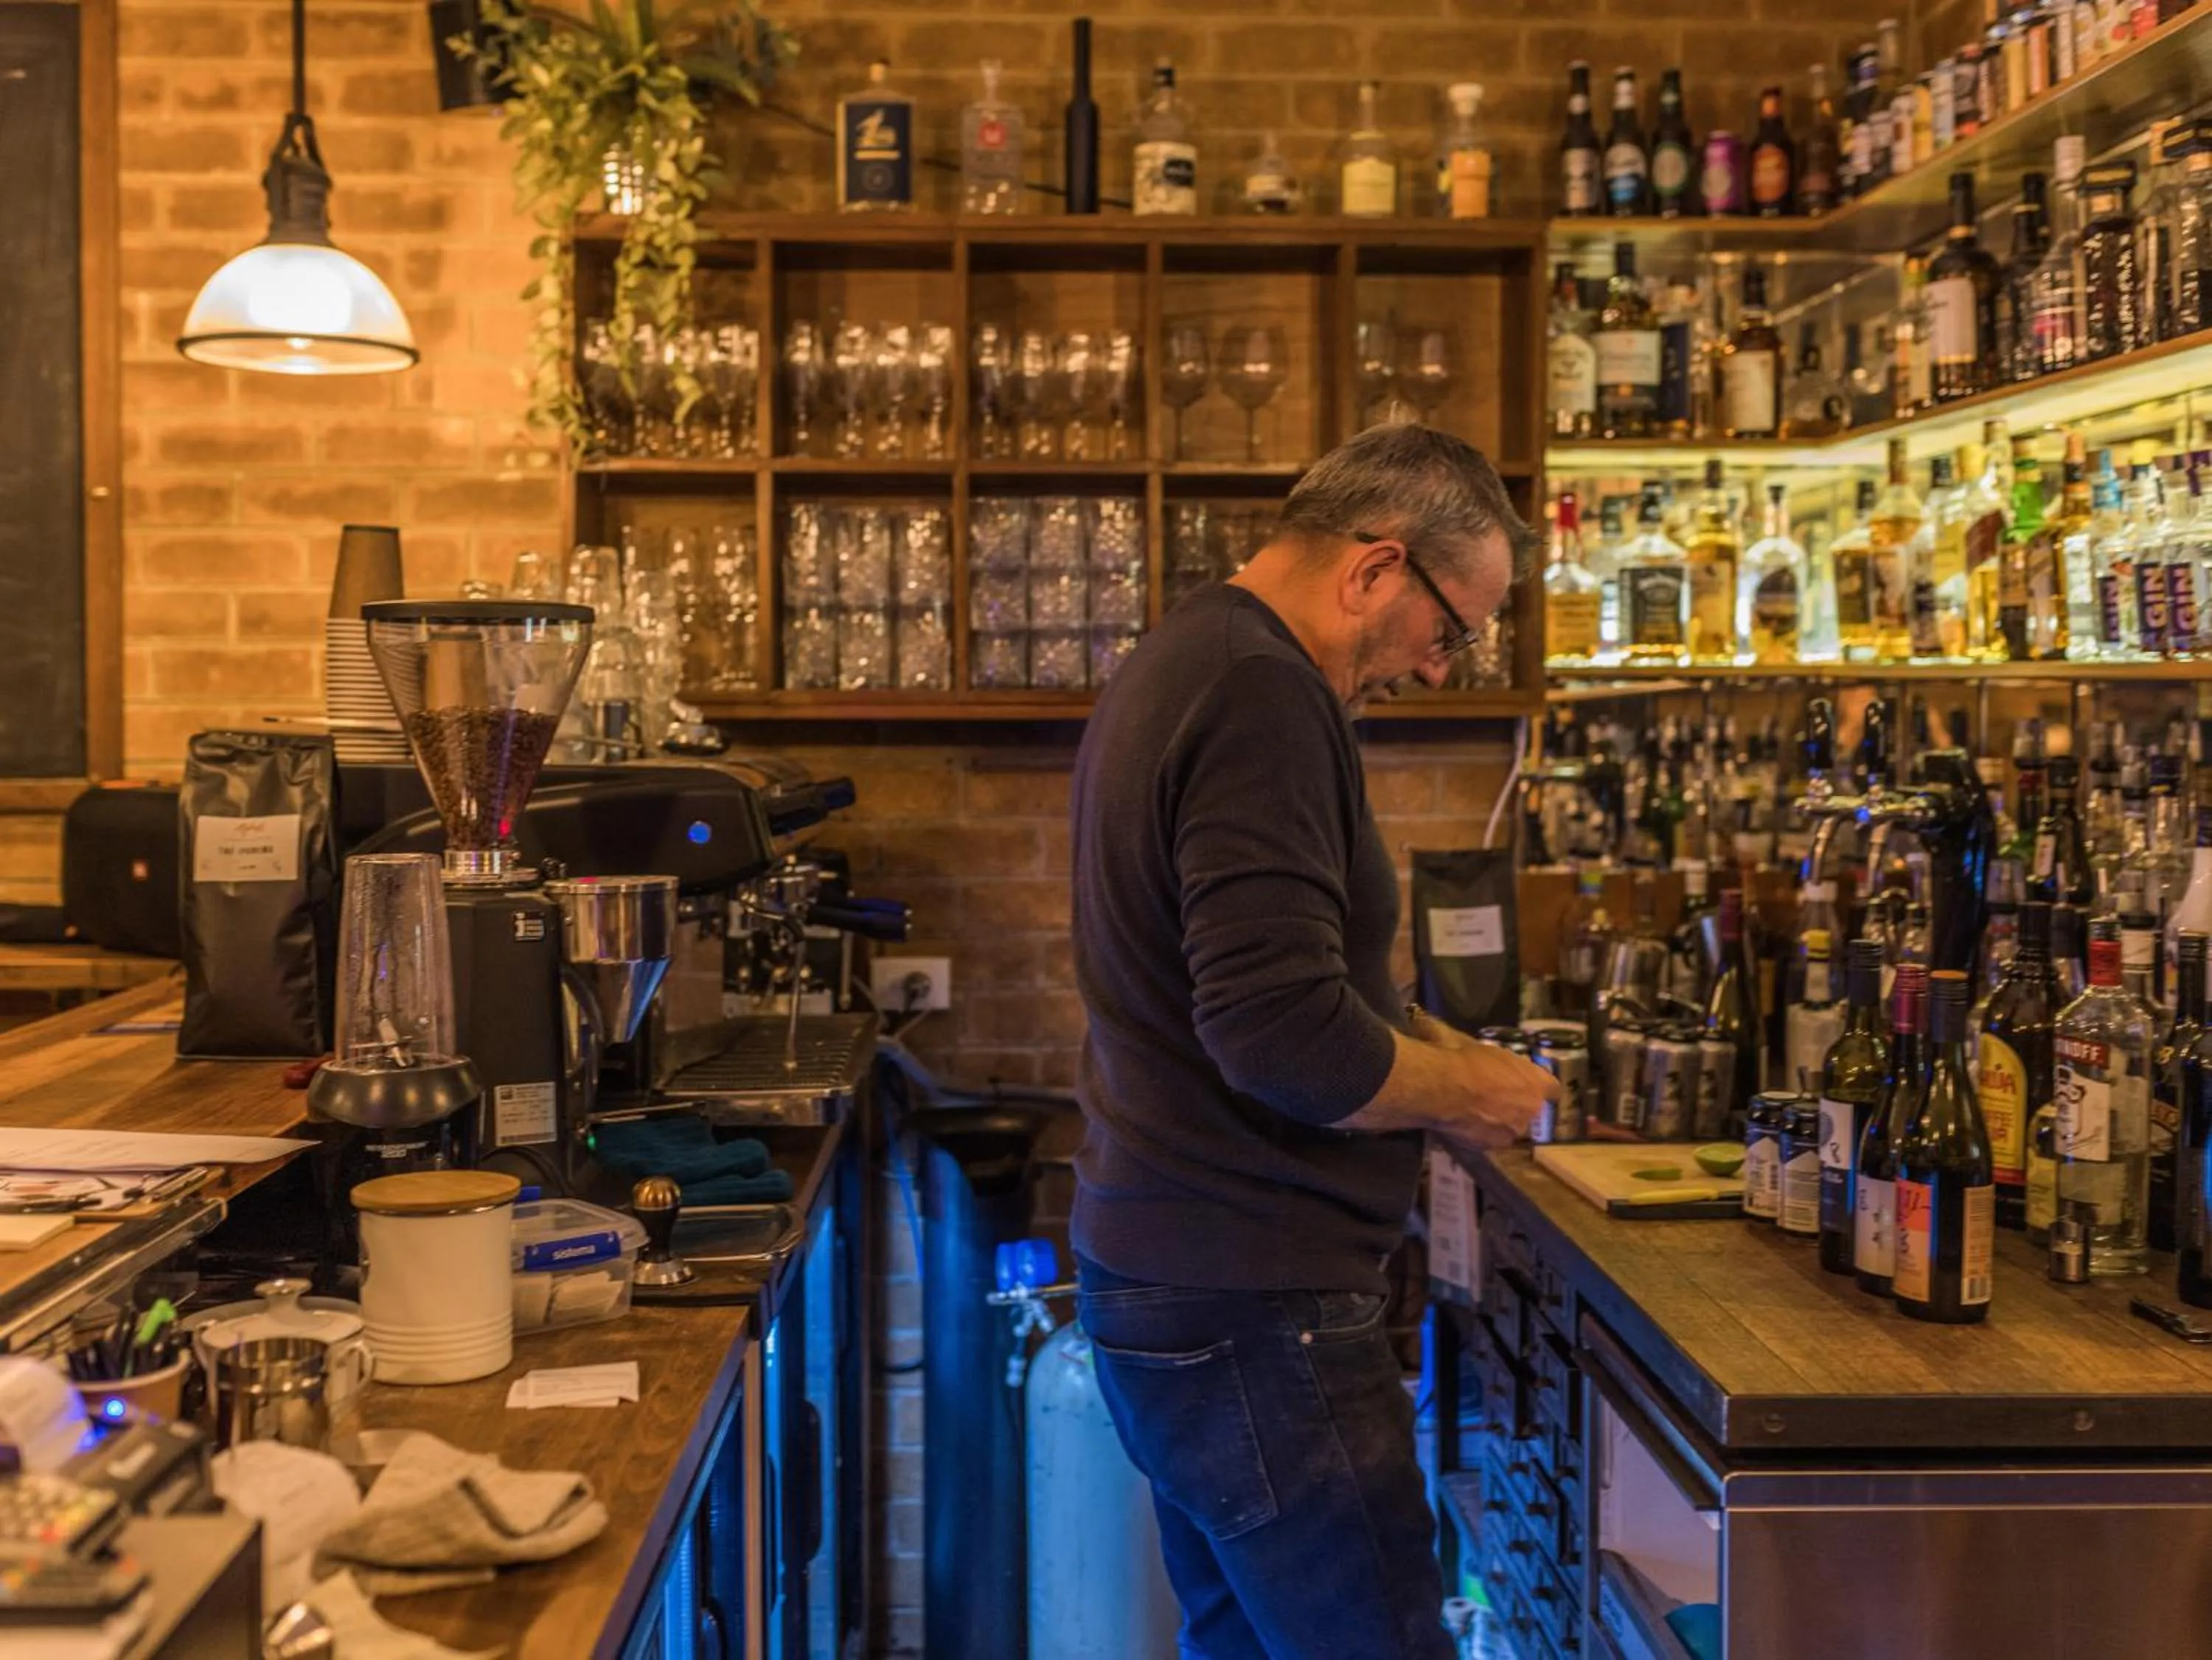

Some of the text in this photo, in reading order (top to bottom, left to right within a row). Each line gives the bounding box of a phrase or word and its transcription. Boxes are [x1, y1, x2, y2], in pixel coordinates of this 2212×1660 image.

[2143, 567, 2168, 630] GIN
[2174, 568, 2198, 631] GIN
[552, 1244, 596, 1260] sistema
